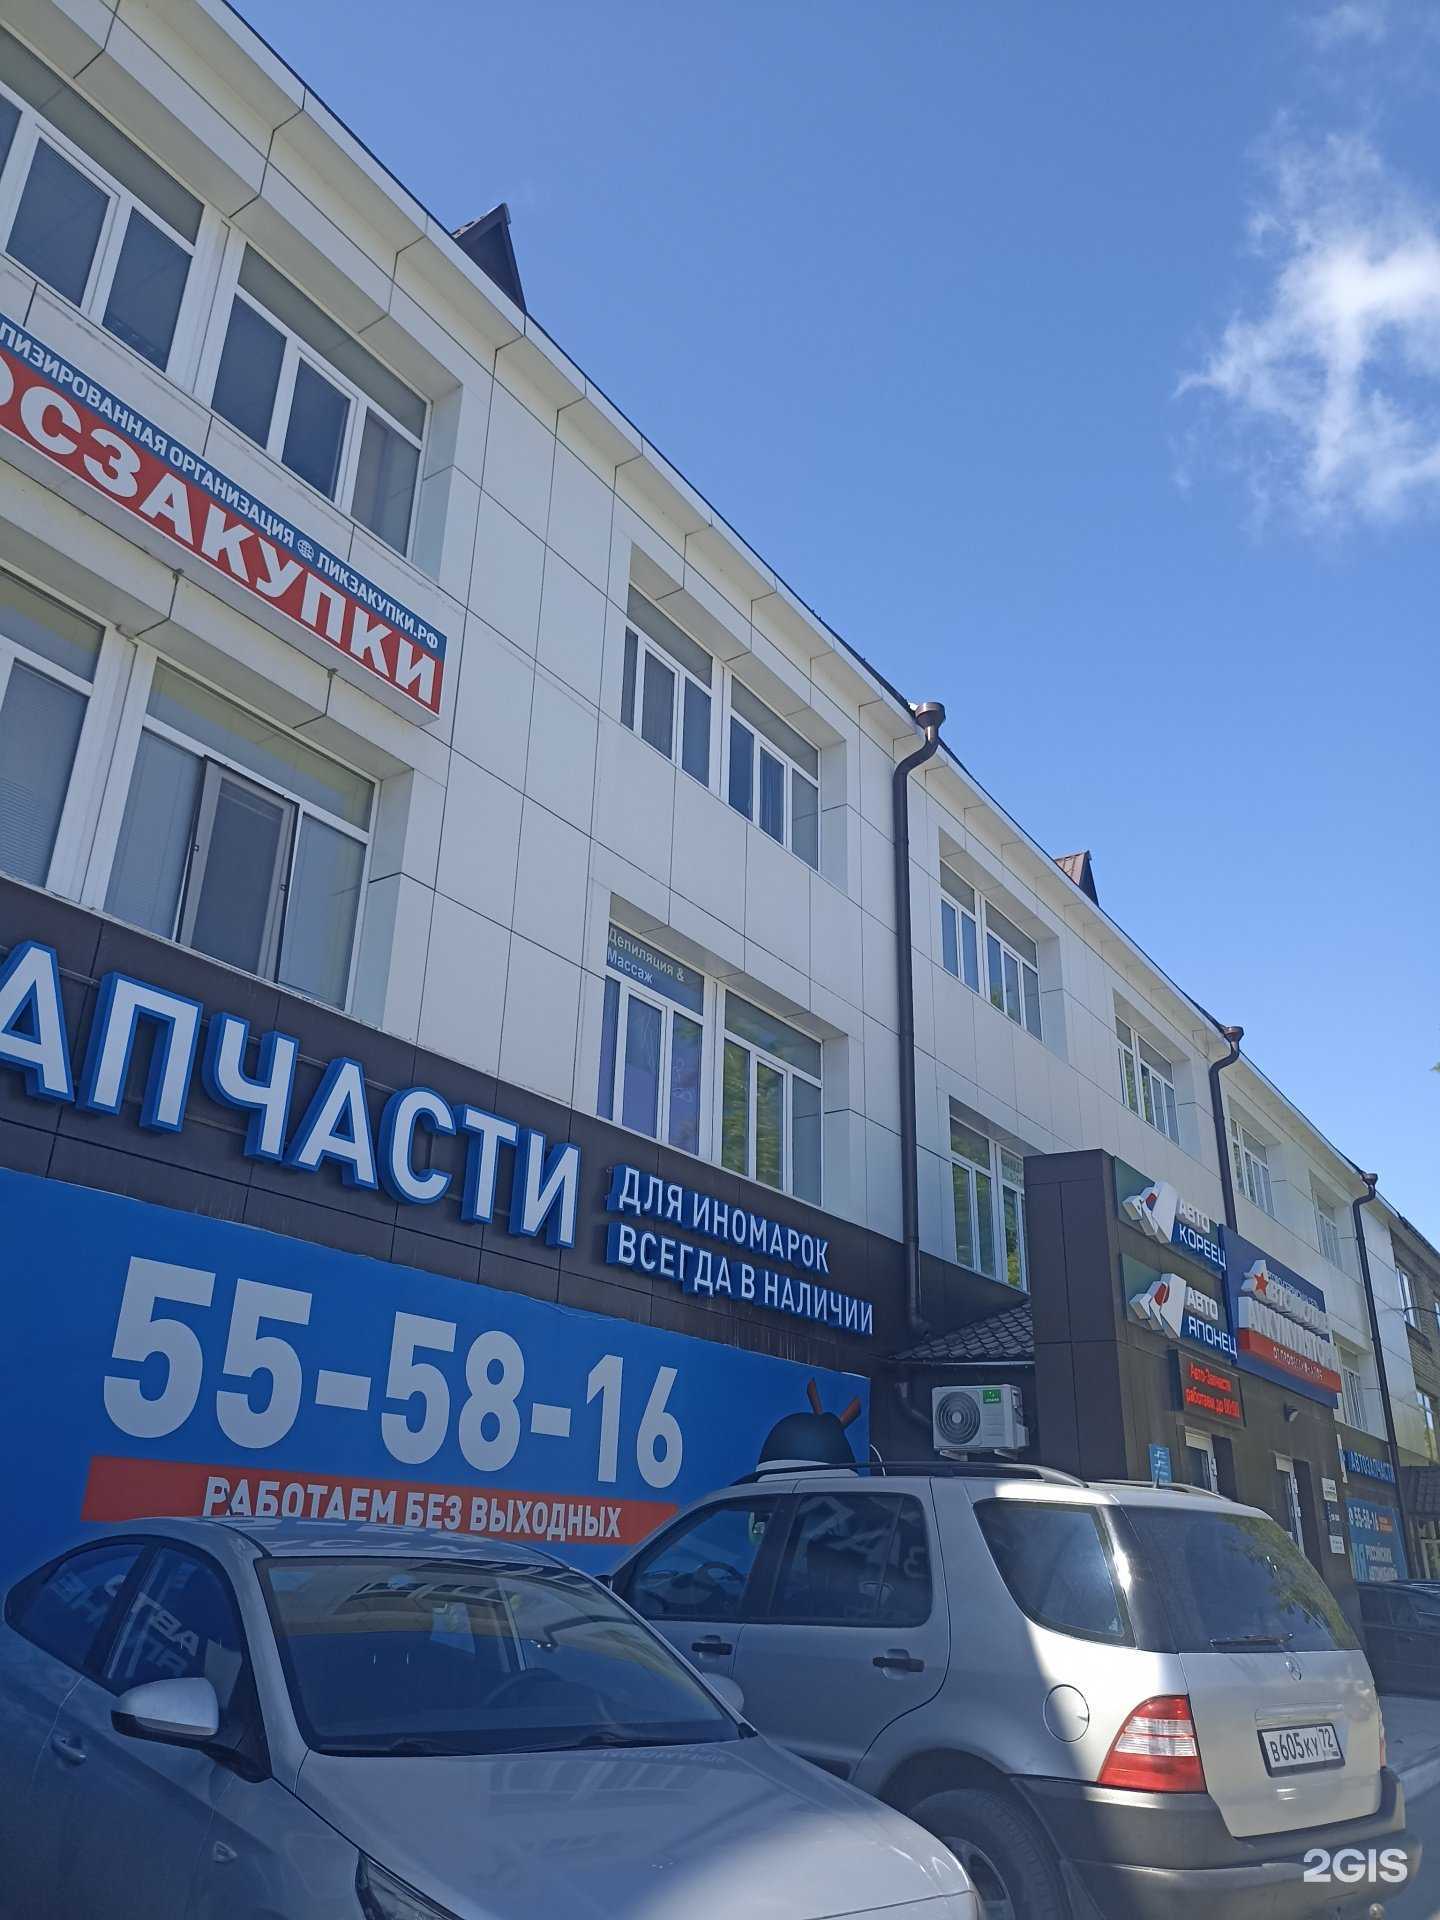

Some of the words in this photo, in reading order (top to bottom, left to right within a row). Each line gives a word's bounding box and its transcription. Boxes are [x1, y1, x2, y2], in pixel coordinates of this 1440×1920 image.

[0, 355, 437, 706] СЗАКУПКИ
[169, 446, 295, 548] ОРГАНИЗАЦИЯ
[317, 551, 439, 650] ЛИКЗАКУПКИ.РФ
[607, 949, 654, 985] Массаж
[608, 928, 674, 975] Депиляция
[676, 967, 686, 983] &
[0, 942, 581, 1247] АПЧАСТИ
[618, 1167, 683, 1222] ДЛЯ
[692, 1192, 830, 1274] ИНОМАРОК
[1178, 1200, 1211, 1234] АВТО
[1179, 1223, 1227, 1271] КОРЕЕЦ
[618, 1223, 732, 1296] ВСЕГДА
[741, 1263, 755, 1300] В
[764, 1270, 873, 1335] НАЛИЧИИ
[1185, 1286, 1219, 1320] АВТО
[1188, 1316, 1238, 1360] ЯПОНЕЦ
[104, 1255, 684, 1489] 55-58-16
[203, 1476, 399, 1528] РАБОТАЕМ
[402, 1490, 462, 1531] БЕЗ
[470, 1497, 622, 1542] ВЫХОДНЫХ
[1320, 1728, 1334, 1749] 72
